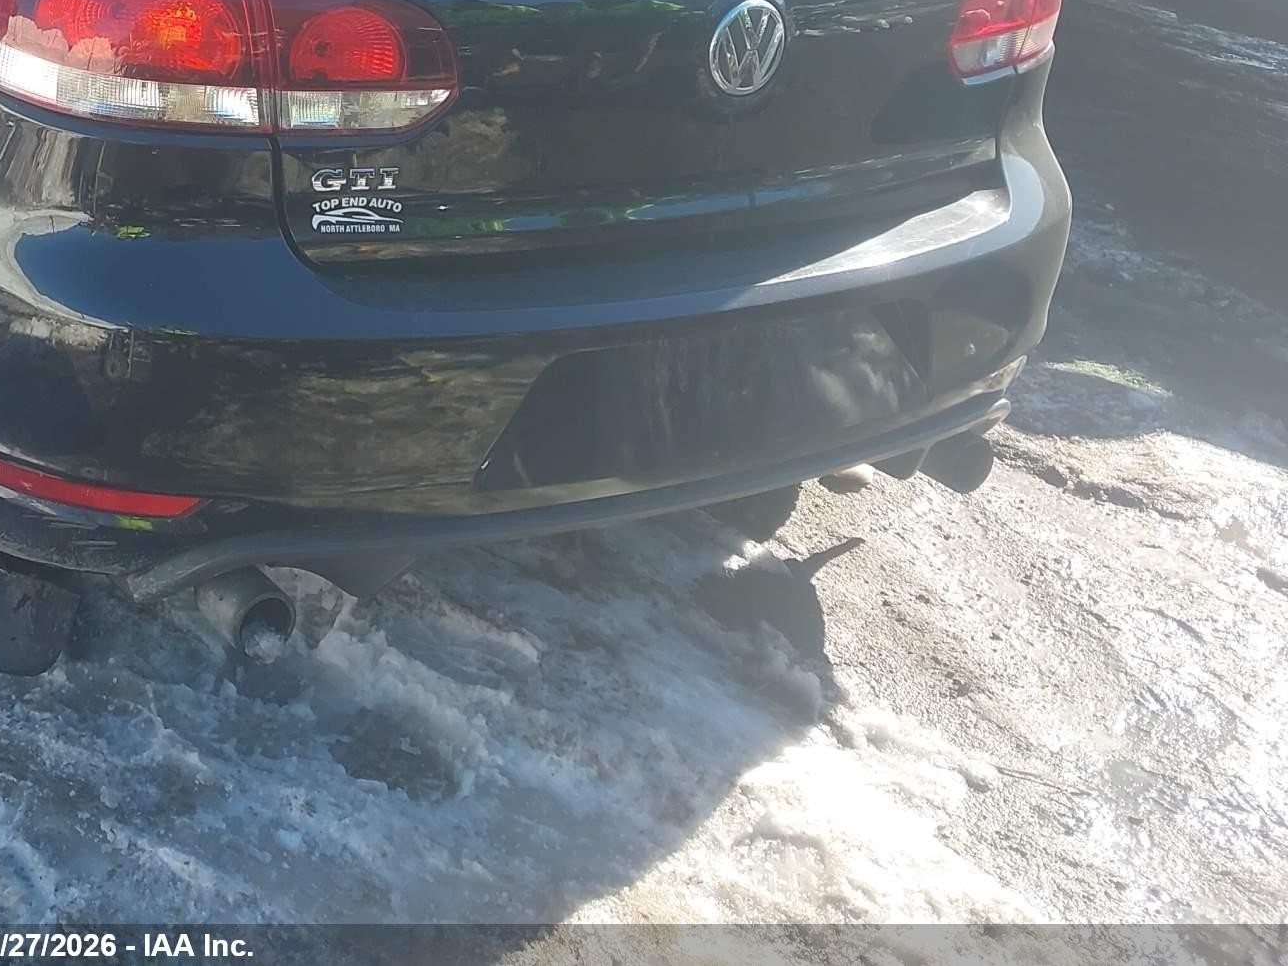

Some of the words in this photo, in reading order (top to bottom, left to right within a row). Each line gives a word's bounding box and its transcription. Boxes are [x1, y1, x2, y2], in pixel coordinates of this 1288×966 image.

[312, 167, 399, 191] GTI
[312, 199, 339, 212] TOP
[342, 197, 367, 207] END
[369, 198, 402, 212] AUTO
[320, 224, 345, 232] NORTH
[346, 224, 385, 232] ATTLEBORO
[388, 224, 401, 232] MA
